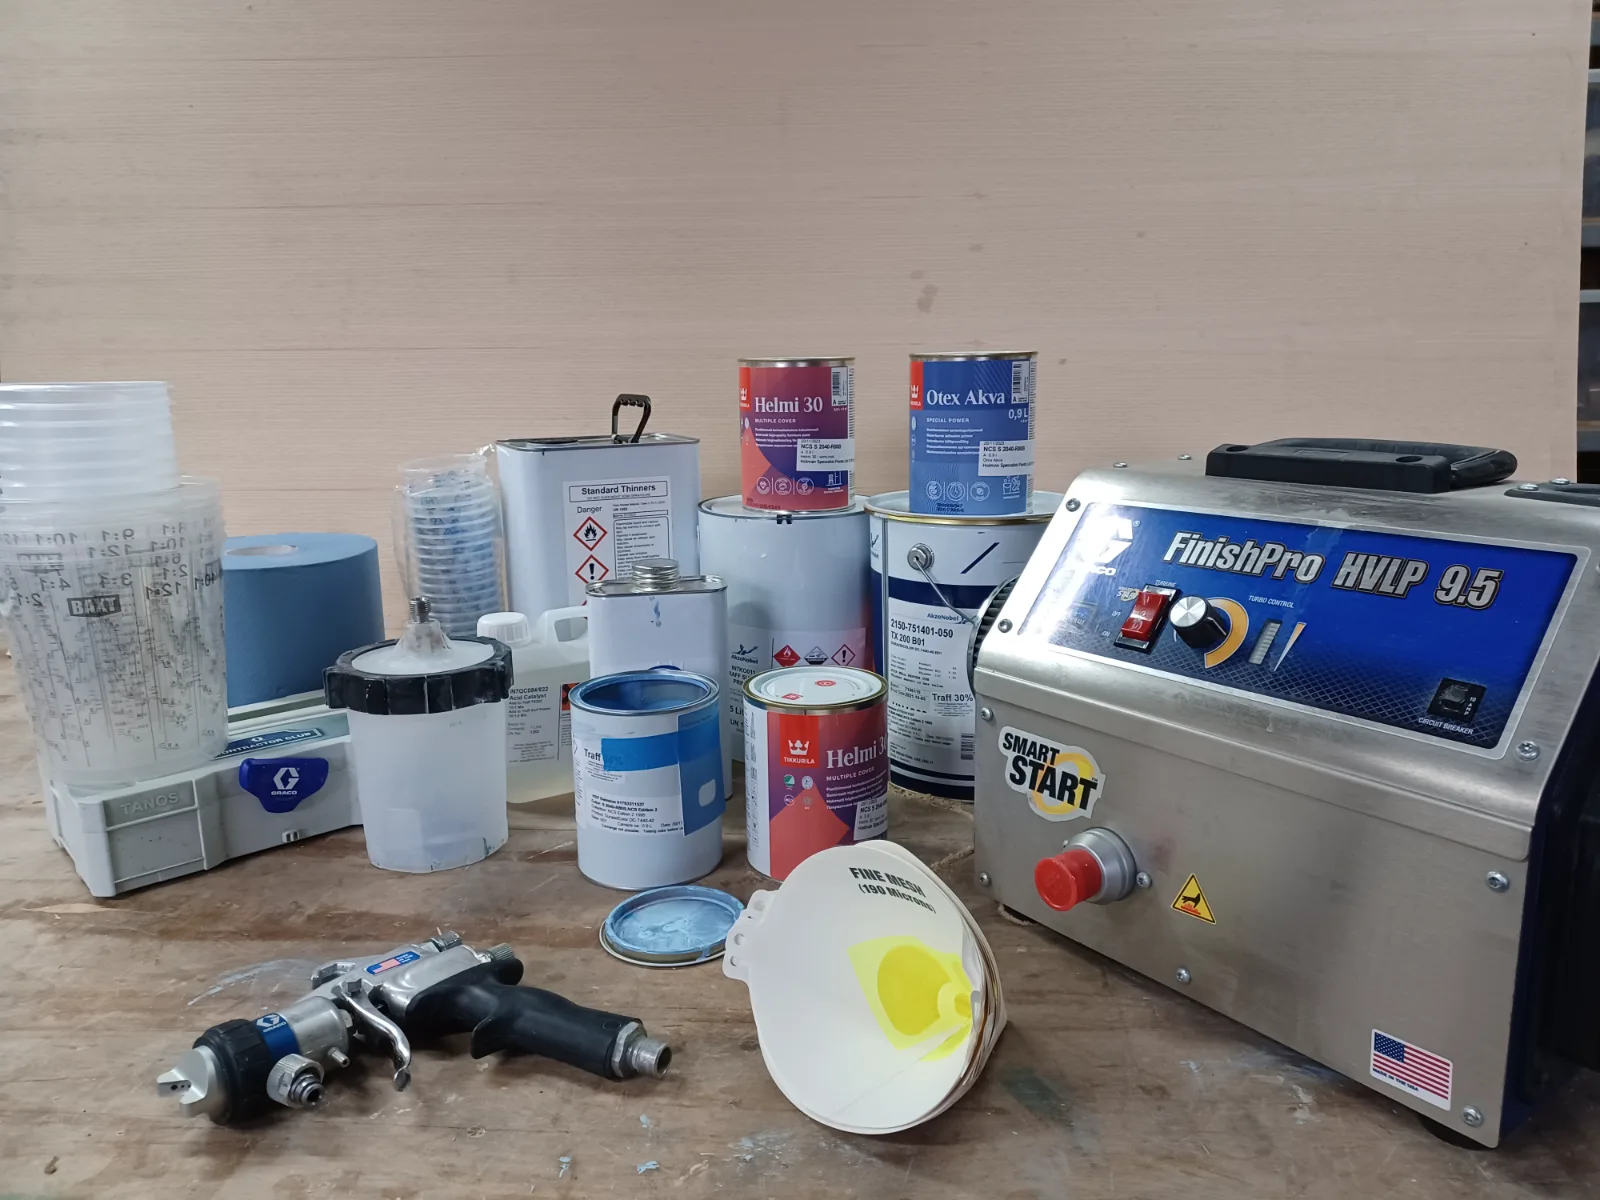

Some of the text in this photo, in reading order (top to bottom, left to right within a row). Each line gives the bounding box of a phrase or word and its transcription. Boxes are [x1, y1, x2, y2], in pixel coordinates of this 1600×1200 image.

[755, 396, 823, 413] Helmi 30
[926, 388, 1006, 405] Otex Akva
[581, 484, 656, 495] Standard Thinners
[576, 506, 603, 514] Danger
[1161, 530, 1504, 611] FinishPro HVLP 9.5
[1248, 594, 1295, 609] TURBO CONTROL
[926, 612, 959, 622] AkzoNobel
[890, 618, 954, 639] 2150-751401-050
[890, 630, 925, 647] TX 200 B01
[931, 692, 974, 702] Traff 30%
[729, 705, 734, 713] 5
[1417, 717, 1474, 735] CIRCUIT BREAKER
[583, 747, 602, 762] Traff
[826, 741, 878, 769] Helmi
[1003, 732, 1061, 767] SMART
[783, 756, 816, 765] TIKKURILA
[826, 766, 875, 781] MULTIPLE COVER
[1009, 755, 1099, 811] START
[120, 792, 178, 815] TANOS
[848, 866, 927, 899] FINE MESH
[857, 883, 887, 896] (190
[1372, 1067, 1388, 1078] MADE
[1395, 1077, 1407, 1086] THE
[1406, 1082, 1419, 1092] USA
